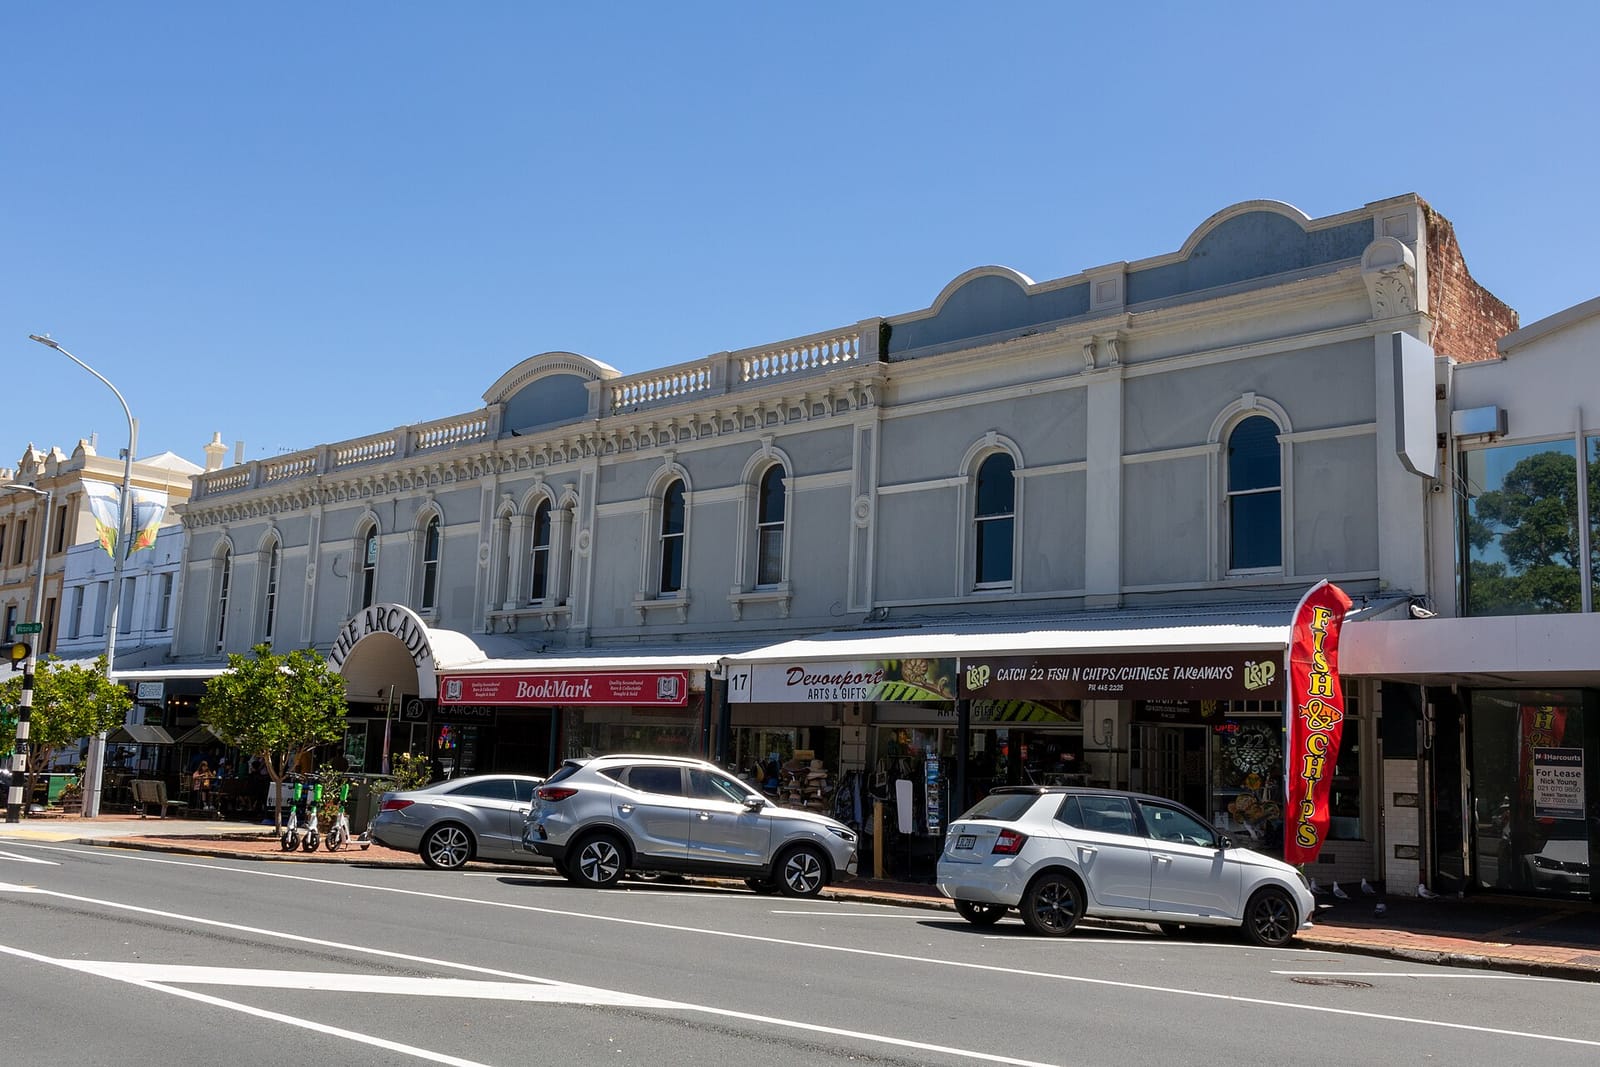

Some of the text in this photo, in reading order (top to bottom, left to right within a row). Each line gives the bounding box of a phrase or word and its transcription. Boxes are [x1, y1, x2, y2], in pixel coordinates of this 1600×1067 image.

[329, 606, 429, 668] THE ARCADE
[1309, 606, 1335, 697] FISH
[732, 674, 747, 690] 17
[786, 666, 884, 689] Devonport
[997, 667, 1028, 681] CATCH
[1030, 668, 1044, 681] 22
[1072, 667, 1081, 682] N
[516, 679, 592, 698] BookMark
[808, 687, 867, 700] ARTS & GIFTS
[1243, 734, 1264, 750] 22
[1547, 753, 1581, 761] Harcourts
[1536, 769, 1581, 778] For Lease
[1297, 733, 1329, 846] CHIPS
[1557, 779, 1577, 787] Young
